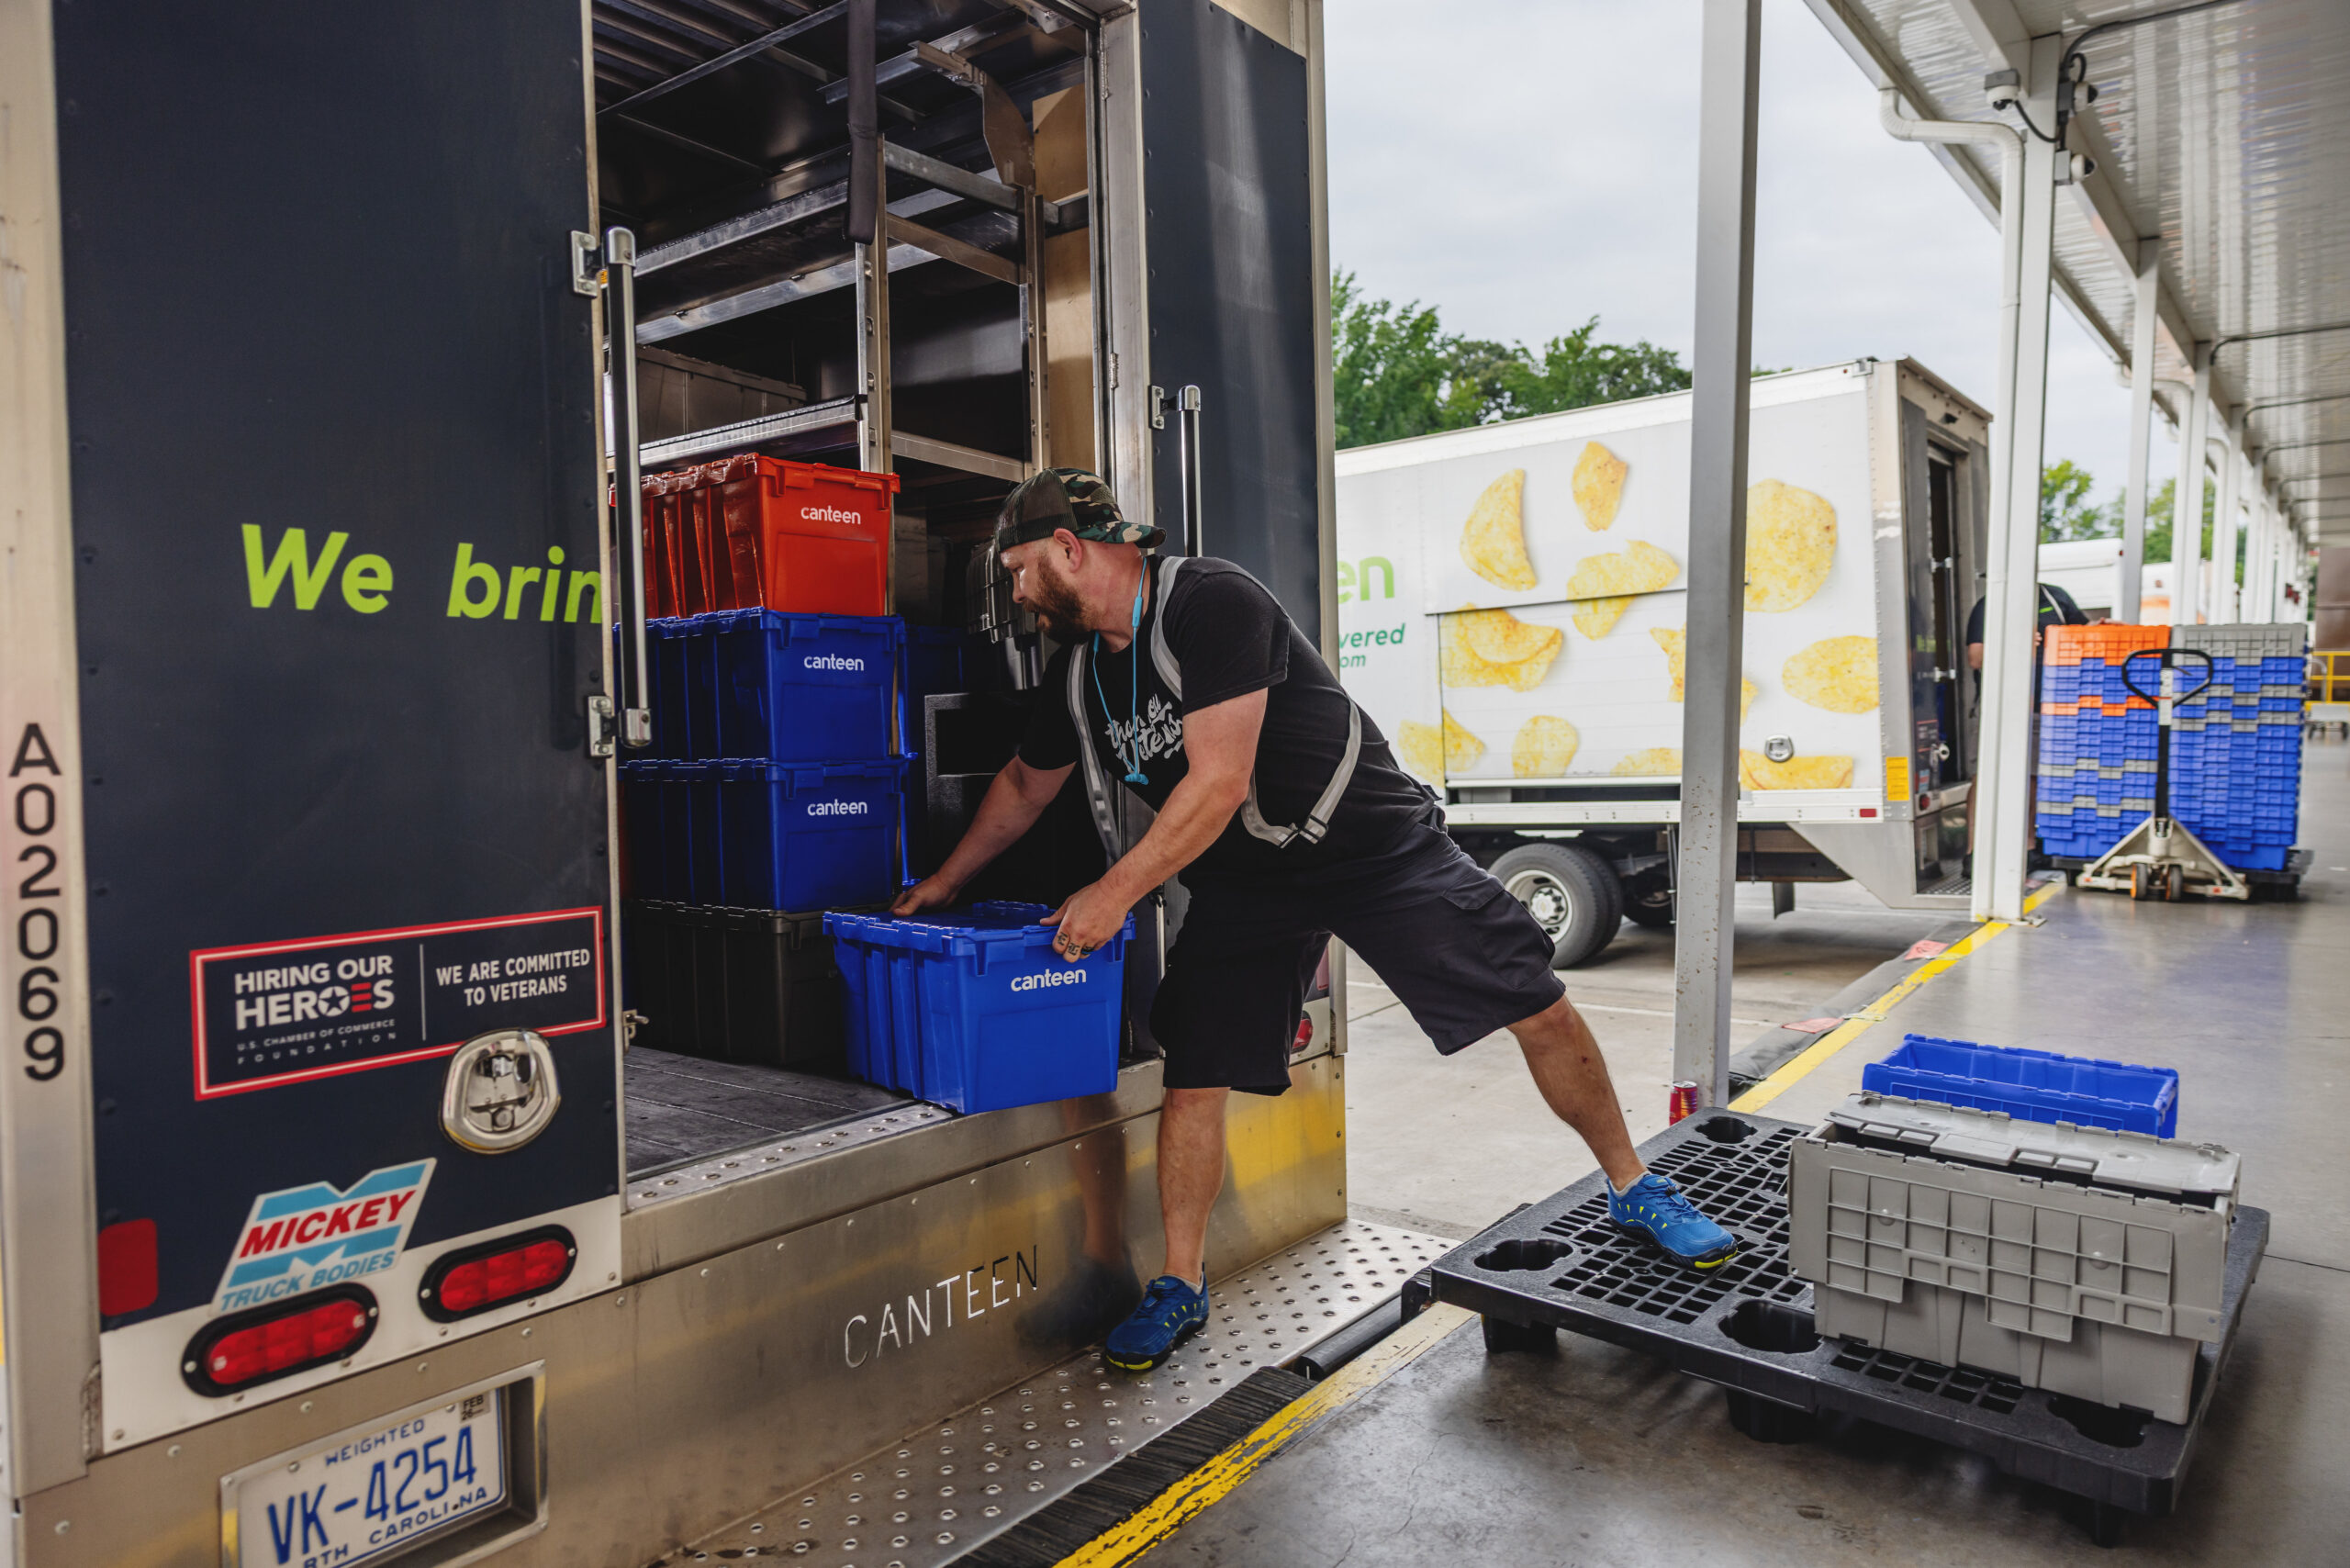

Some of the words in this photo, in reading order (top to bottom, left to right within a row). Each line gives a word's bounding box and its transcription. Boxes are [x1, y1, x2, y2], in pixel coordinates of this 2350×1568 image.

[800, 505, 861, 524] canteen
[241, 523, 394, 613] We
[447, 543, 602, 623] brin
[804, 653, 865, 671] canteen
[807, 799, 867, 816] canteen
[8, 722, 65, 1082] A02069
[234, 962, 330, 995] HIRING
[337, 955, 394, 980] OUR
[436, 965, 464, 987] WE
[468, 959, 501, 982] ARE
[505, 948, 591, 977] COMMITTED
[1011, 969, 1087, 992] canteen
[235, 979, 396, 1031] HEROES
[464, 986, 487, 1007] TO
[489, 974, 568, 1003] VETERANS
[263, 1030, 317, 1047] CHAMBER
[319, 1027, 334, 1038] OF
[337, 1018, 396, 1036] COMMERCE
[239, 1189, 418, 1260] MICKEY
[220, 1273, 306, 1313] TRUCK
[309, 1249, 397, 1288] BODIES
[845, 1244, 1037, 1369] CANTEEN
[463, 1394, 484, 1410] FEB
[325, 1418, 425, 1467] WEIGHTED
[267, 1425, 477, 1566] VK-4254
